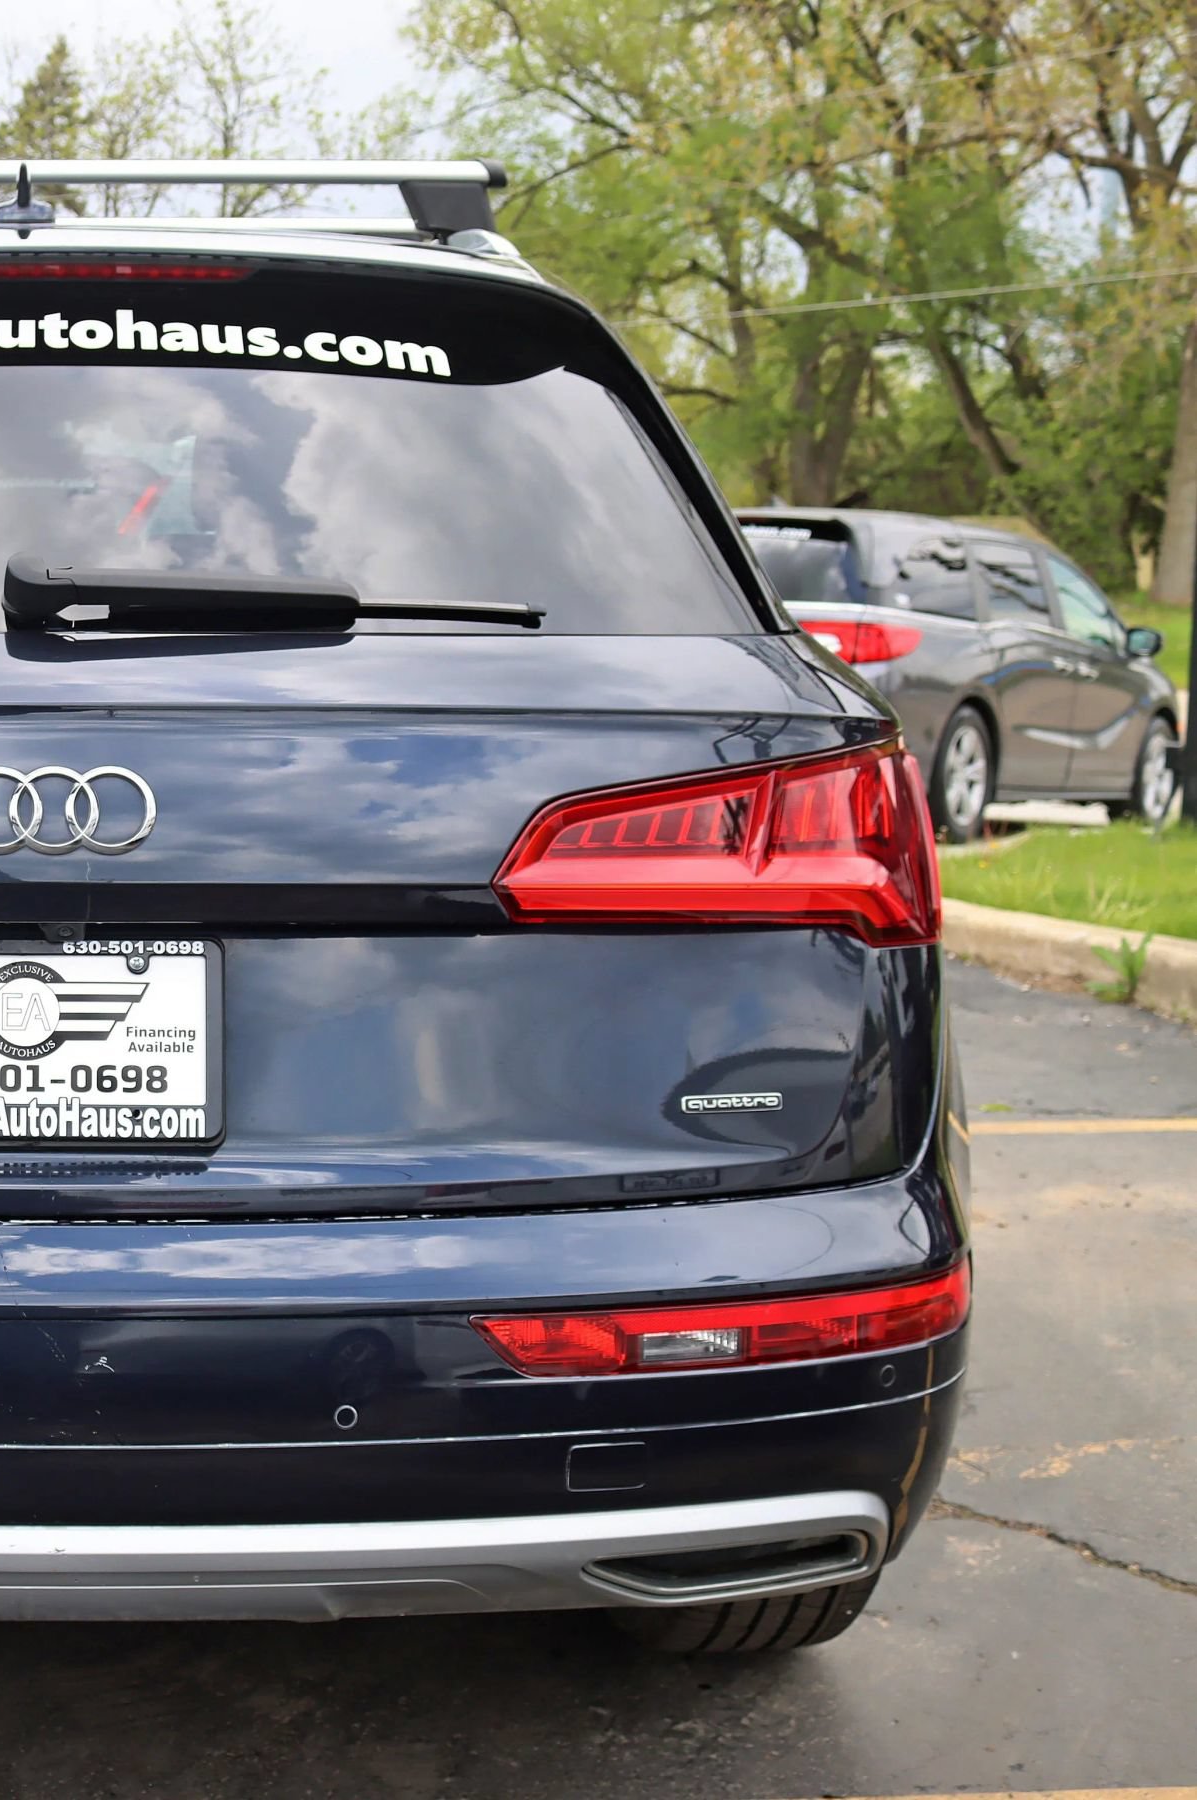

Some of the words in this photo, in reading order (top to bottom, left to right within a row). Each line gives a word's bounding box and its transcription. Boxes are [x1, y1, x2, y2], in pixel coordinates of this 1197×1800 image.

[62, 940, 205, 955] 630-501-0698
[1, 992, 52, 1032] EA
[126, 1026, 196, 1042] Financing
[128, 1041, 195, 1053] Available
[687, 1096, 779, 1112] quattro
